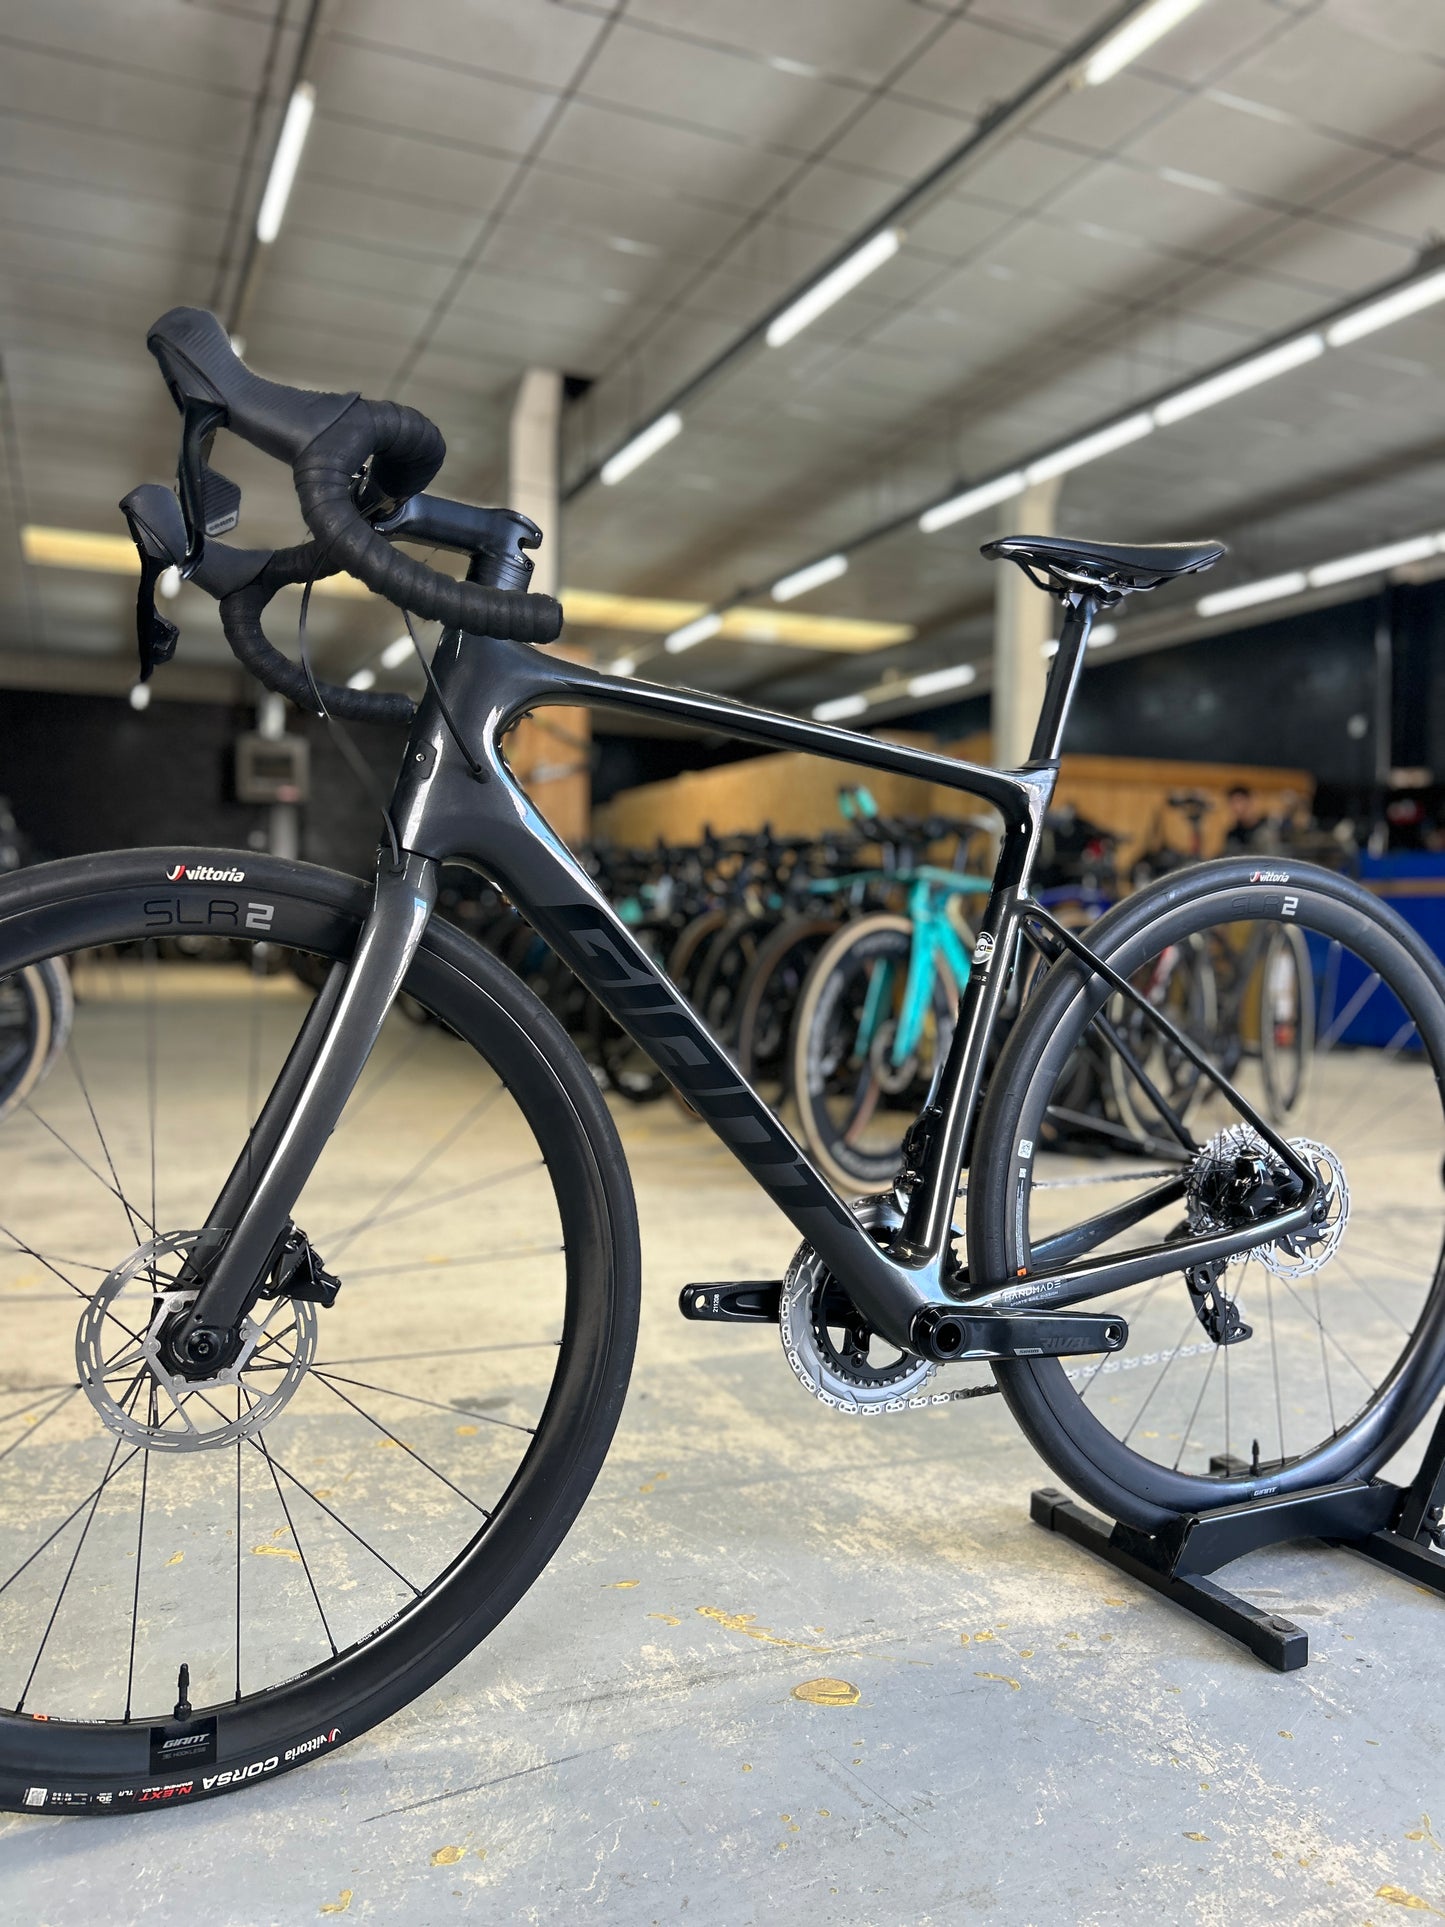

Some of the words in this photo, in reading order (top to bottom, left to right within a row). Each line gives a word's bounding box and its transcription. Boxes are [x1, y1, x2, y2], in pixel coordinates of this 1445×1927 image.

[185, 867, 245, 883] vittoria
[1260, 871, 1290, 883] vittoria
[1004, 1279, 1061, 1302] HANDMADE
[1253, 1486, 1278, 1497] GIANT
[162, 1733, 210, 1749] GIANT
[284, 1734, 328, 1761] vittoria
[202, 1755, 279, 1790] CORSA
[138, 1785, 193, 1802] N.EXT
